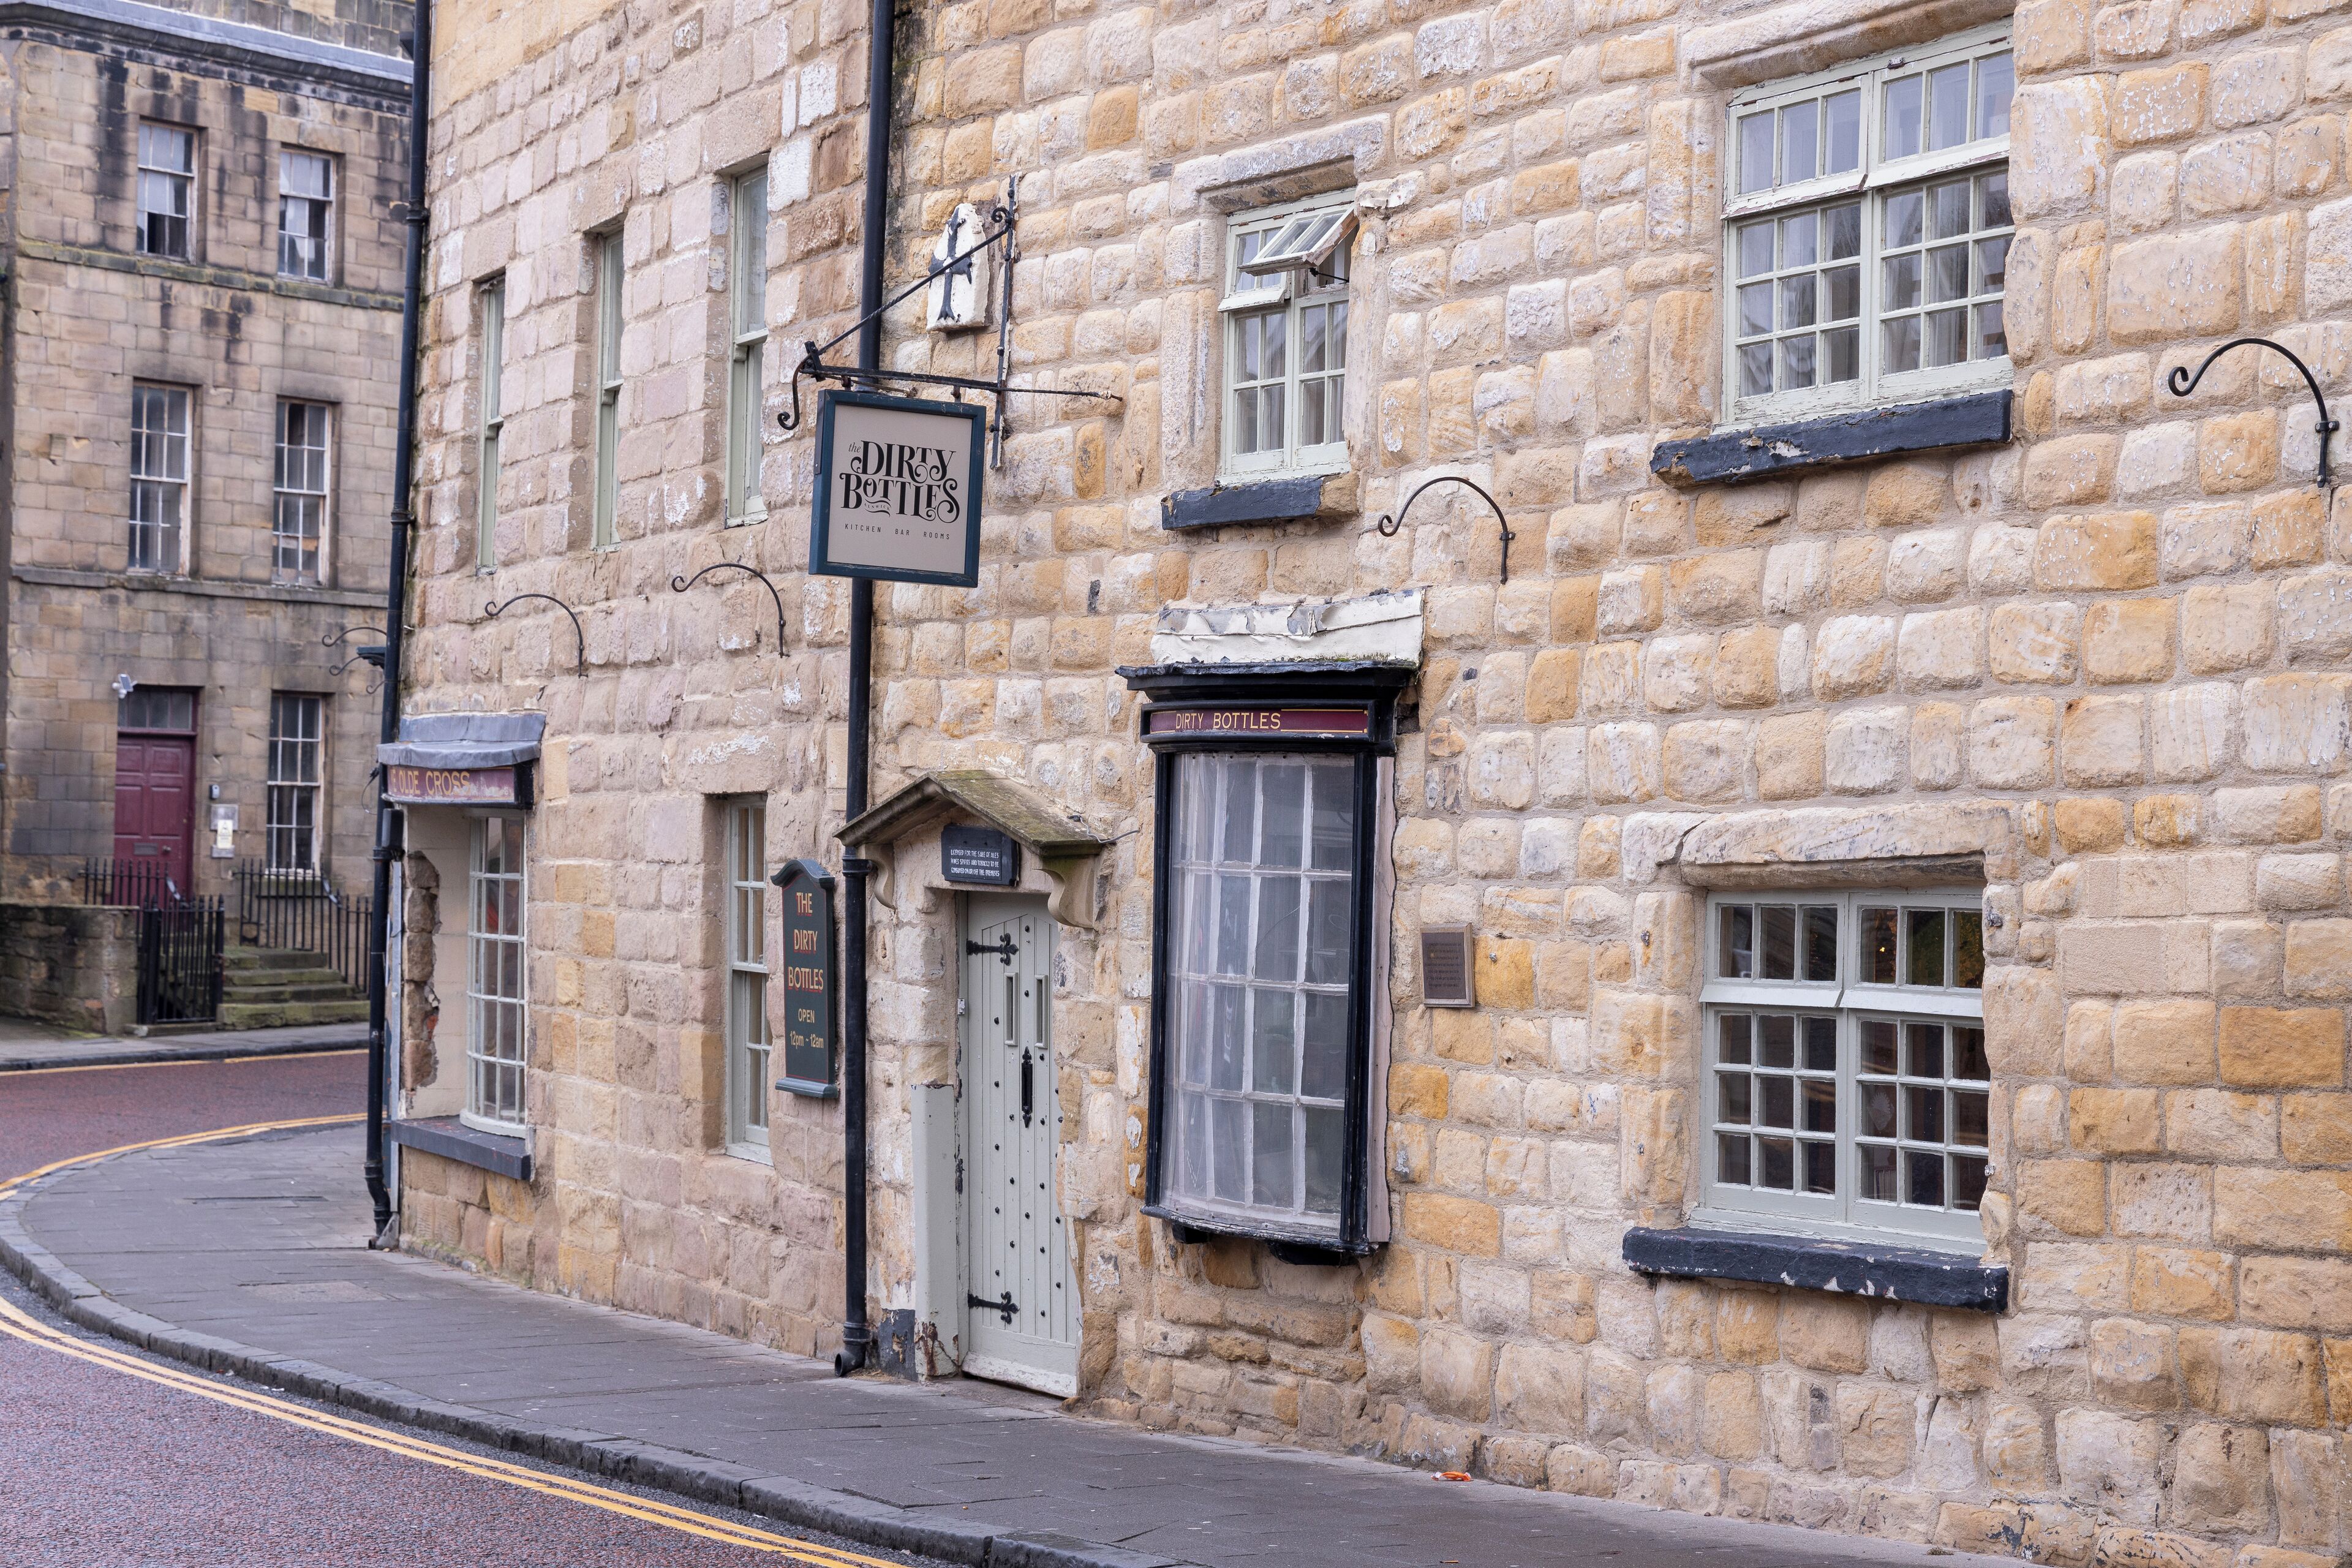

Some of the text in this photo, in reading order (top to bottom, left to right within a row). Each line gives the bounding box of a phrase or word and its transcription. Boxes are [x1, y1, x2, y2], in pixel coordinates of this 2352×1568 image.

[848, 440, 957, 484] the DIRTY
[839, 472, 960, 524] BOTTLES
[845, 523, 881, 533] KITCHEN
[924, 531, 950, 540] ROOMS
[1175, 712, 1281, 729] DIRTY BOTTLES
[399, 770, 420, 794] OLDE
[426, 771, 470, 796] CROSS
[796, 892, 813, 915] THE
[794, 929, 818, 952] DIRTY
[788, 966, 824, 991] BOTTLES
[798, 1008, 815, 1023] OPEN
[790, 1031, 804, 1050] 12pm
[810, 1032, 824, 1049] 12am
